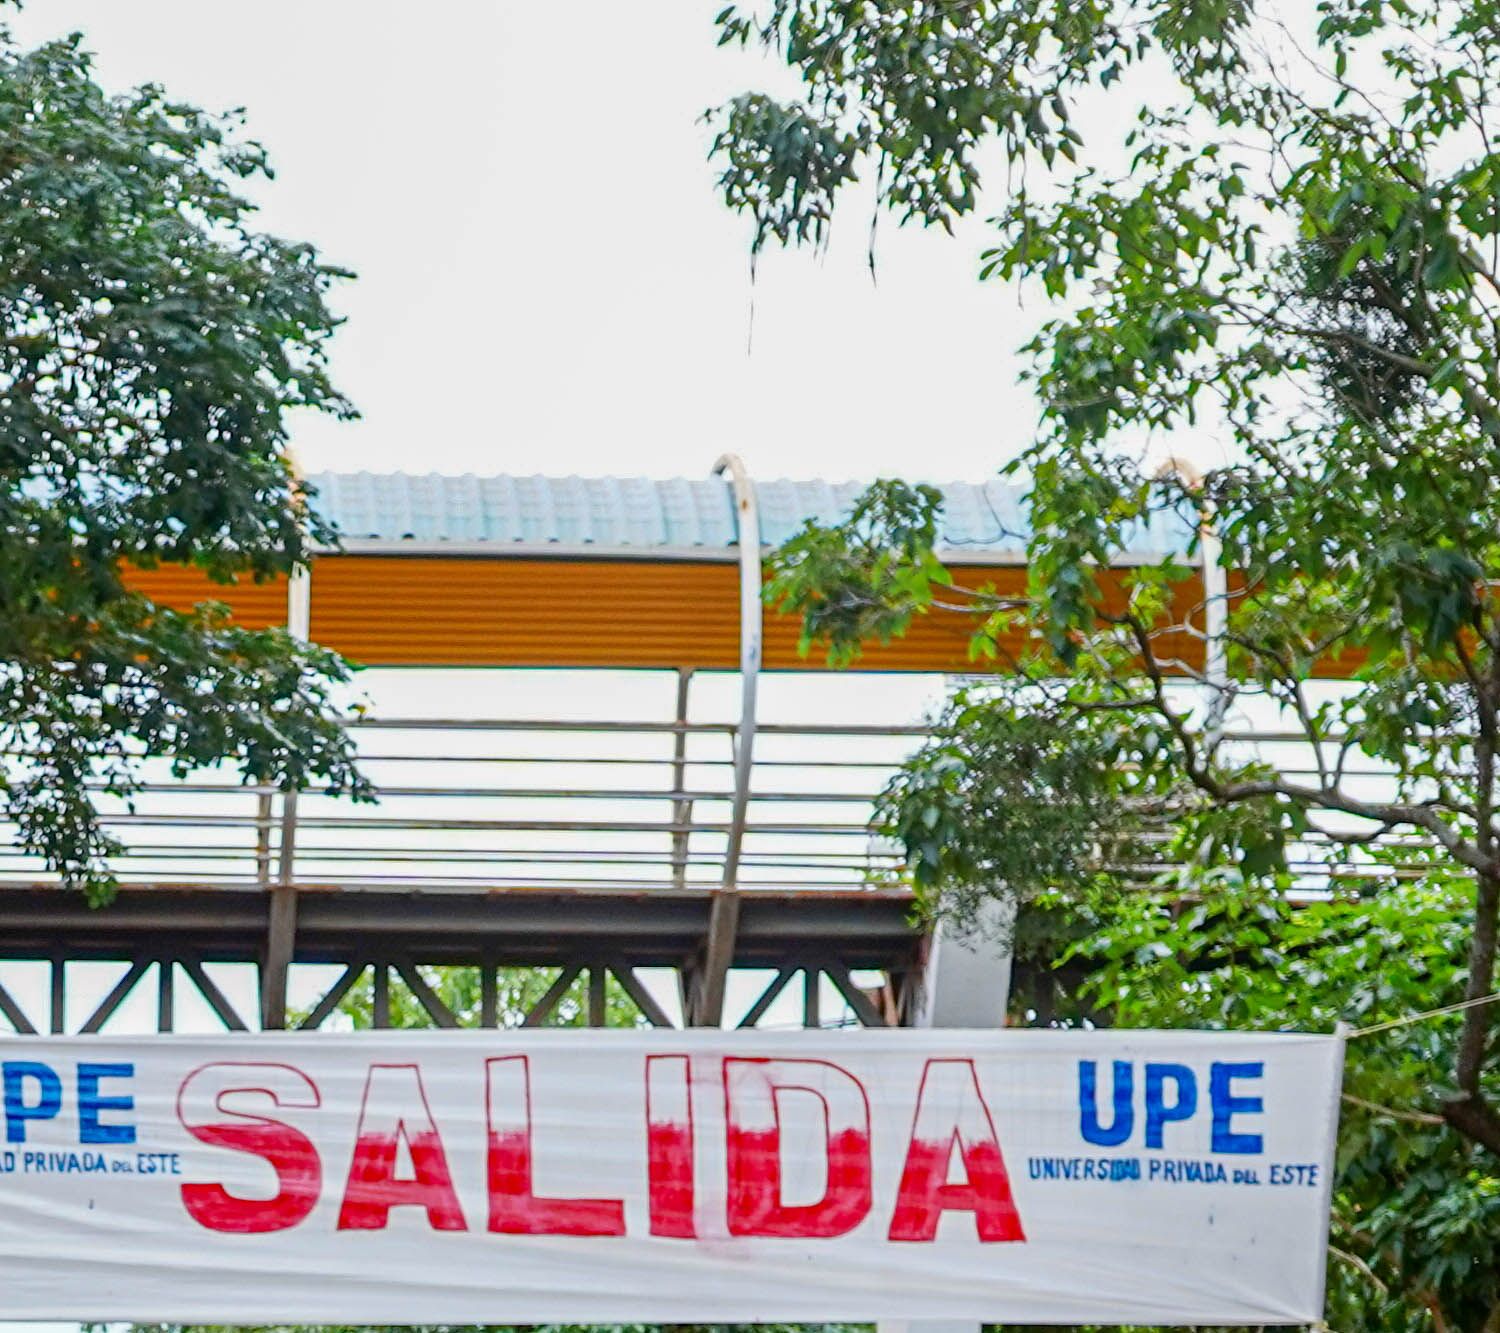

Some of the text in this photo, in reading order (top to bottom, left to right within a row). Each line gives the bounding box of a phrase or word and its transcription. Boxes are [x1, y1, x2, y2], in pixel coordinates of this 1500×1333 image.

[1079, 1060, 1264, 1154] UPE
[24, 1152, 107, 1174] PRIVADA
[137, 1154, 182, 1175] ESTE
[176, 1054, 1027, 1242] SALIDA
[1029, 1158, 1141, 1182] UNIVERSIDAD
[1149, 1159, 1227, 1184] PRIVADA
[1269, 1165, 1318, 1187] ESTE
